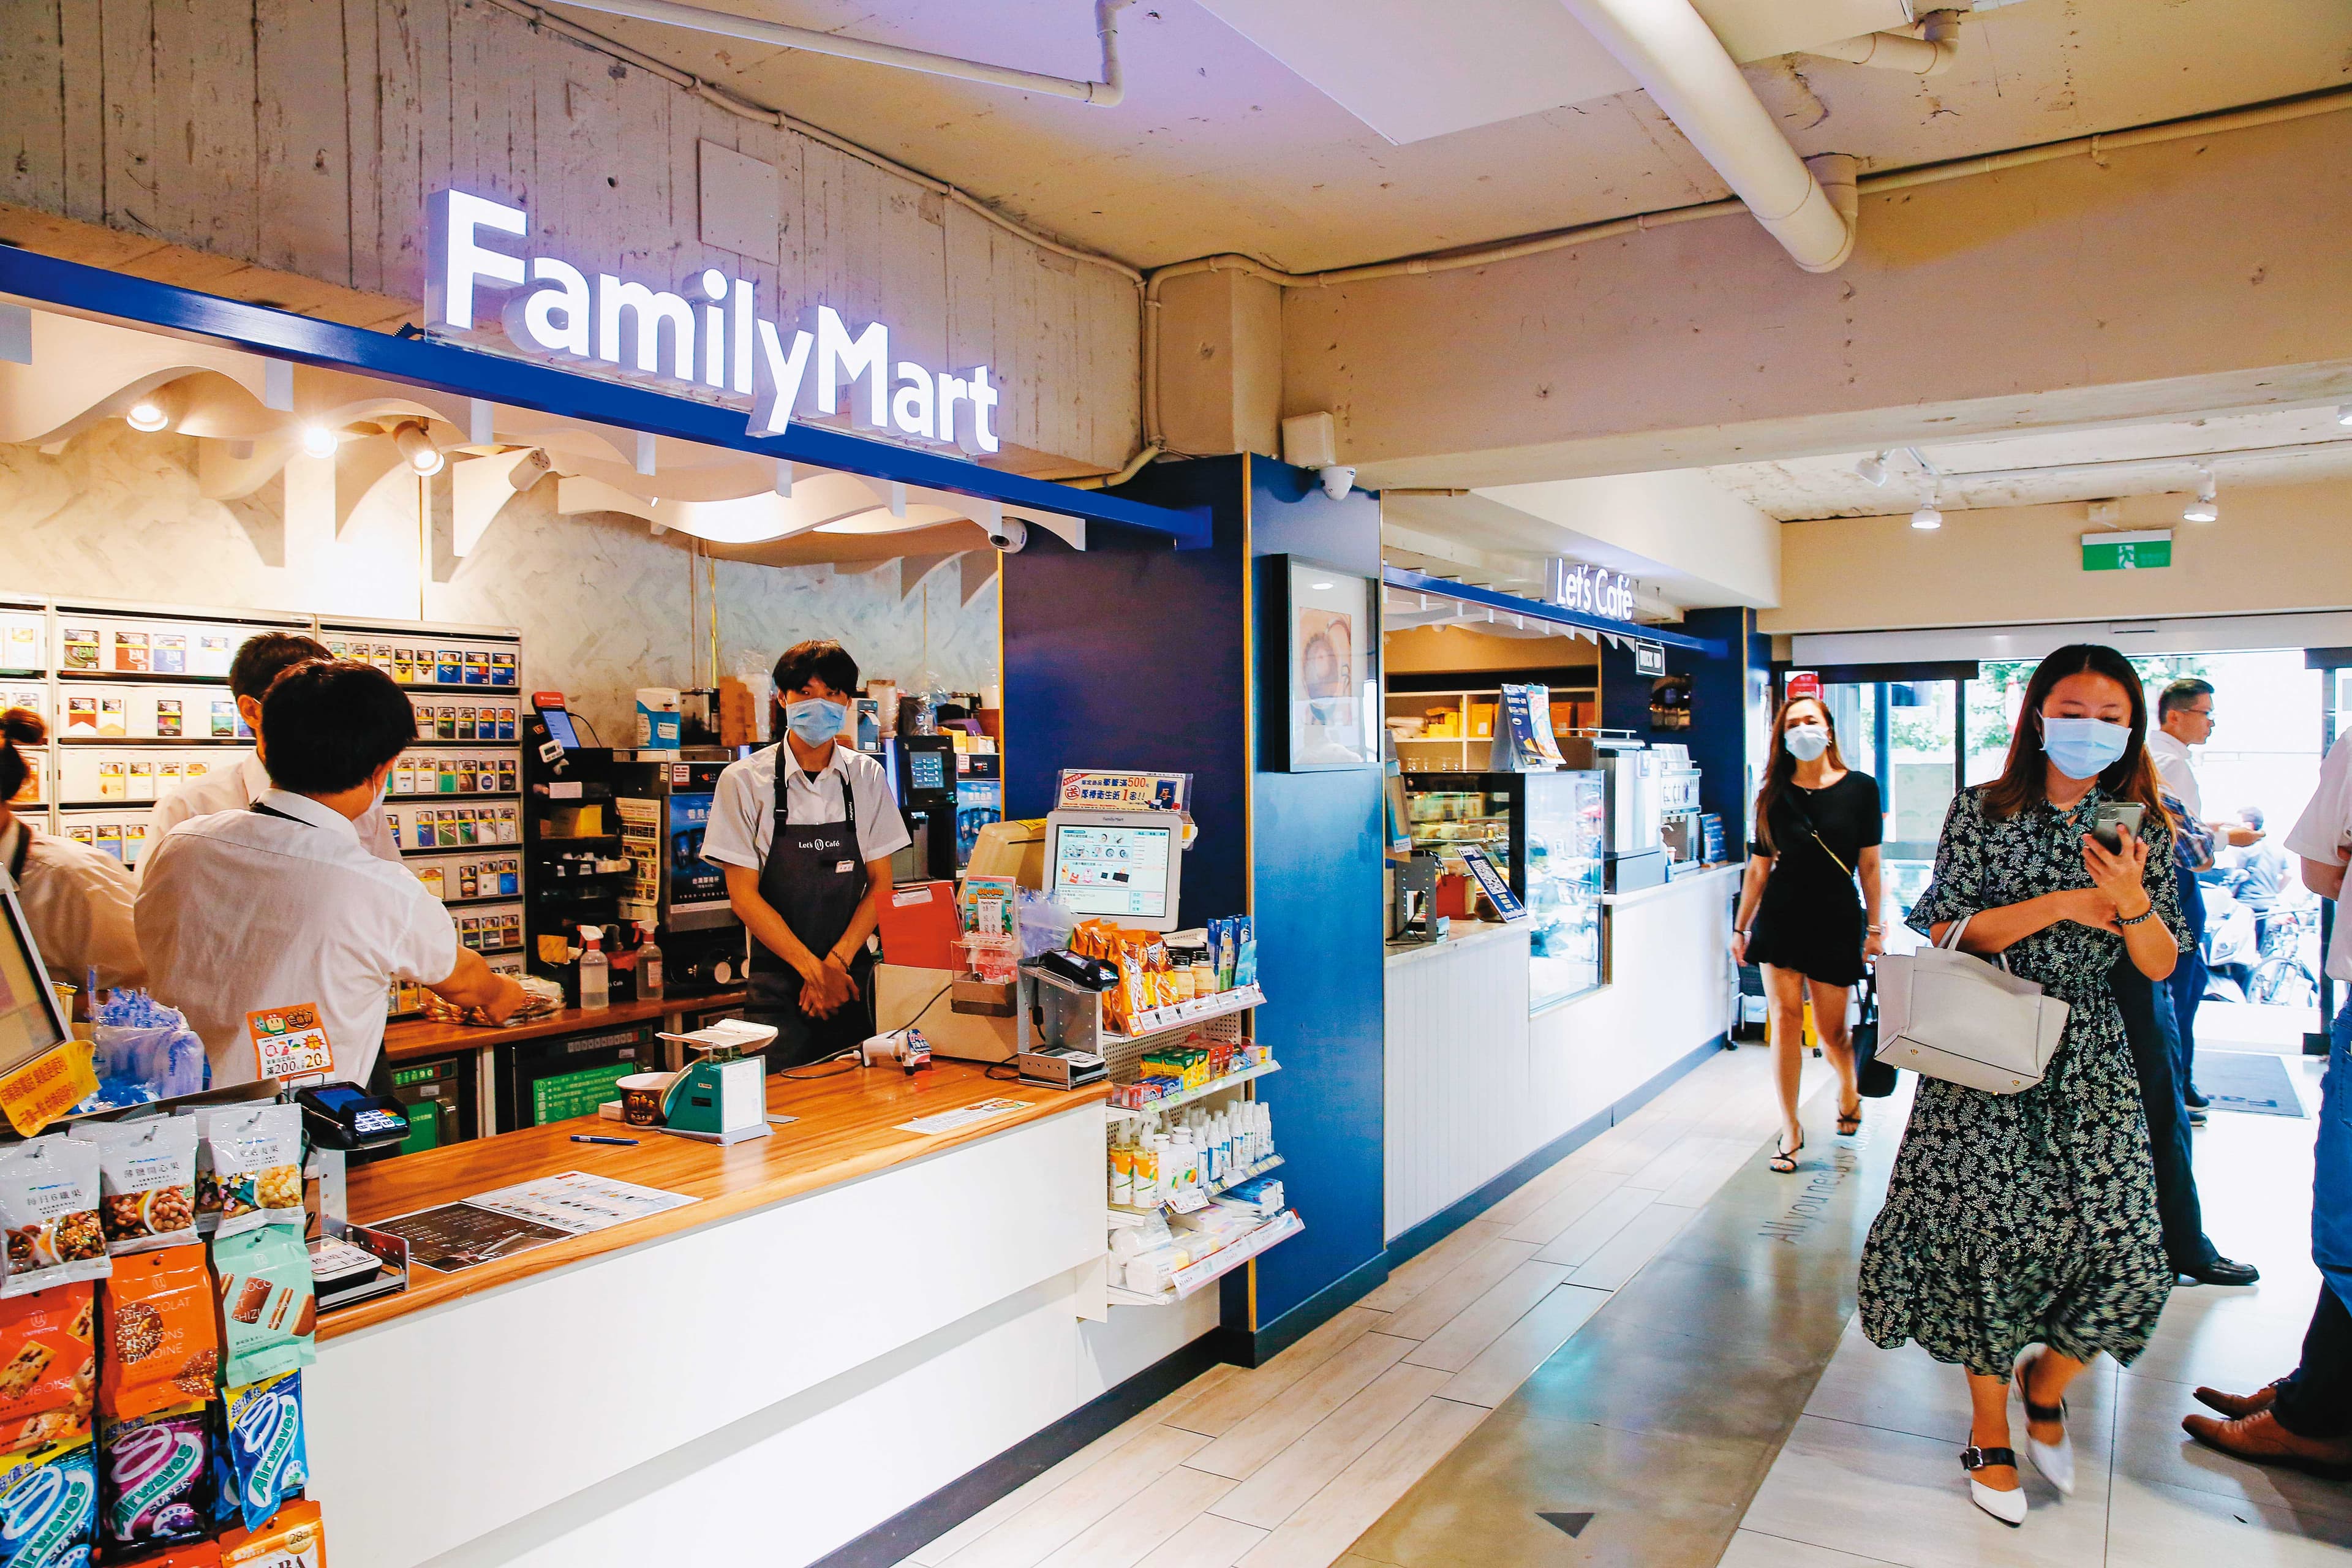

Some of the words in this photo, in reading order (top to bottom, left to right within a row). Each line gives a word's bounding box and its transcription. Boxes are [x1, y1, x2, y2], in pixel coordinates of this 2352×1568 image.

[444, 187, 1000, 454] FamilyMart
[1556, 557, 1592, 611] Let's
[1595, 568, 1634, 621] Café
[1757, 1221, 1807, 1245] All
[1784, 1195, 1830, 1224] you
[124, 1296, 192, 1320] CHOCOLAT
[111, 1443, 194, 1536] Airwaves
[251, 1403, 296, 1502] Airwaves
[9, 1481, 86, 1568] irwaves
